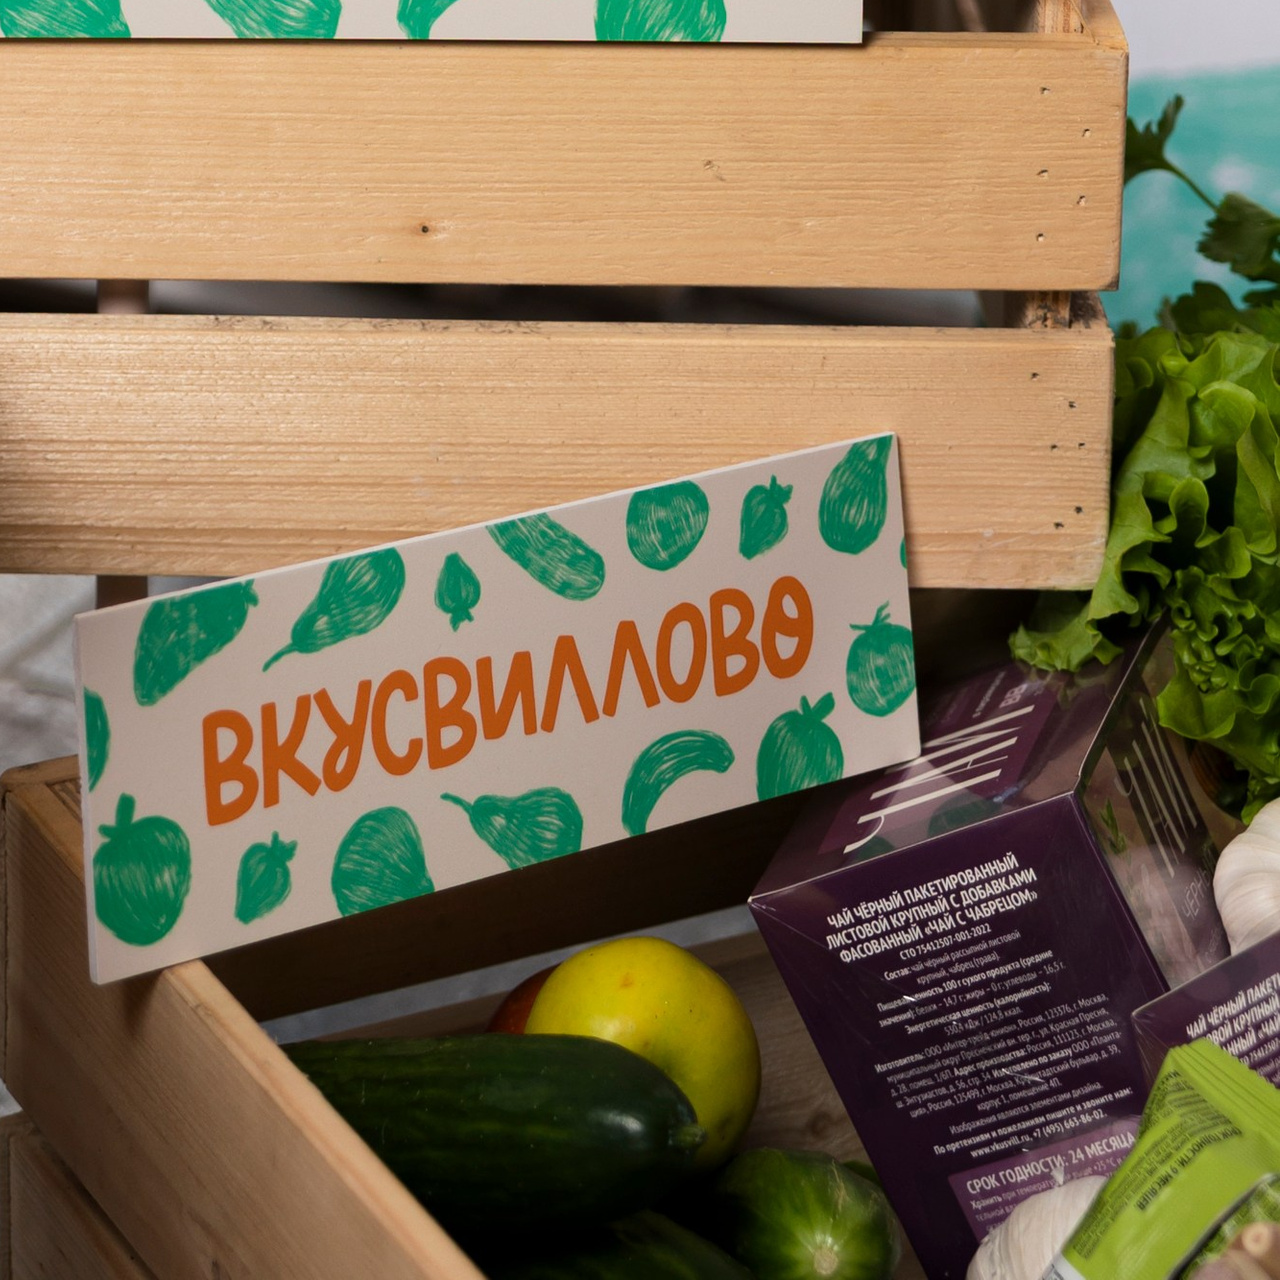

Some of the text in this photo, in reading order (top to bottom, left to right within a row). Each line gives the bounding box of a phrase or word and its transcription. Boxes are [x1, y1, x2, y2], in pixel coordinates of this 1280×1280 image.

[203, 576, 813, 826] ВКУСВИЛЛОВО
[822, 867, 1039, 949] ЛИСТОВОЙ КРУПНЫЙ С ДОБАВКАМИ
[825, 851, 1020, 929] ЧАЙ ЧЁРНЫЙ ПАКЕТИРОВАННЫЙ
[836, 886, 1040, 964] ФАСОВАННЫЙ «ЧАЙ С ЧАБРЕЦОМ»
[898, 922, 992, 960] СТО 75412507-001-2022
[883, 964, 912, 980] Состав:
[986, 929, 1021, 947] листовой
[876, 994, 910, 1012] Пищева
[909, 985, 943, 1002] енность
[941, 979, 958, 991] 100
[960, 972, 987, 987] сухого
[985, 960, 1022, 979] продукта
[960, 1000, 995, 1018] ценность
[1186, 1012, 1207, 1039] ЧАЙ
[1207, 989, 1247, 1026] ЧЁРНЫЙ
[1233, 990, 1280, 1034] КРУПНЫЙ
[923, 1044, 942, 1057] ООО
[1070, 1039, 1090, 1053] ООО
[1041, 1121, 1064, 1136] (495)
[965, 1130, 1138, 1195] СРОК ГОДНОСТИ: 24 МЕСЯЦА
